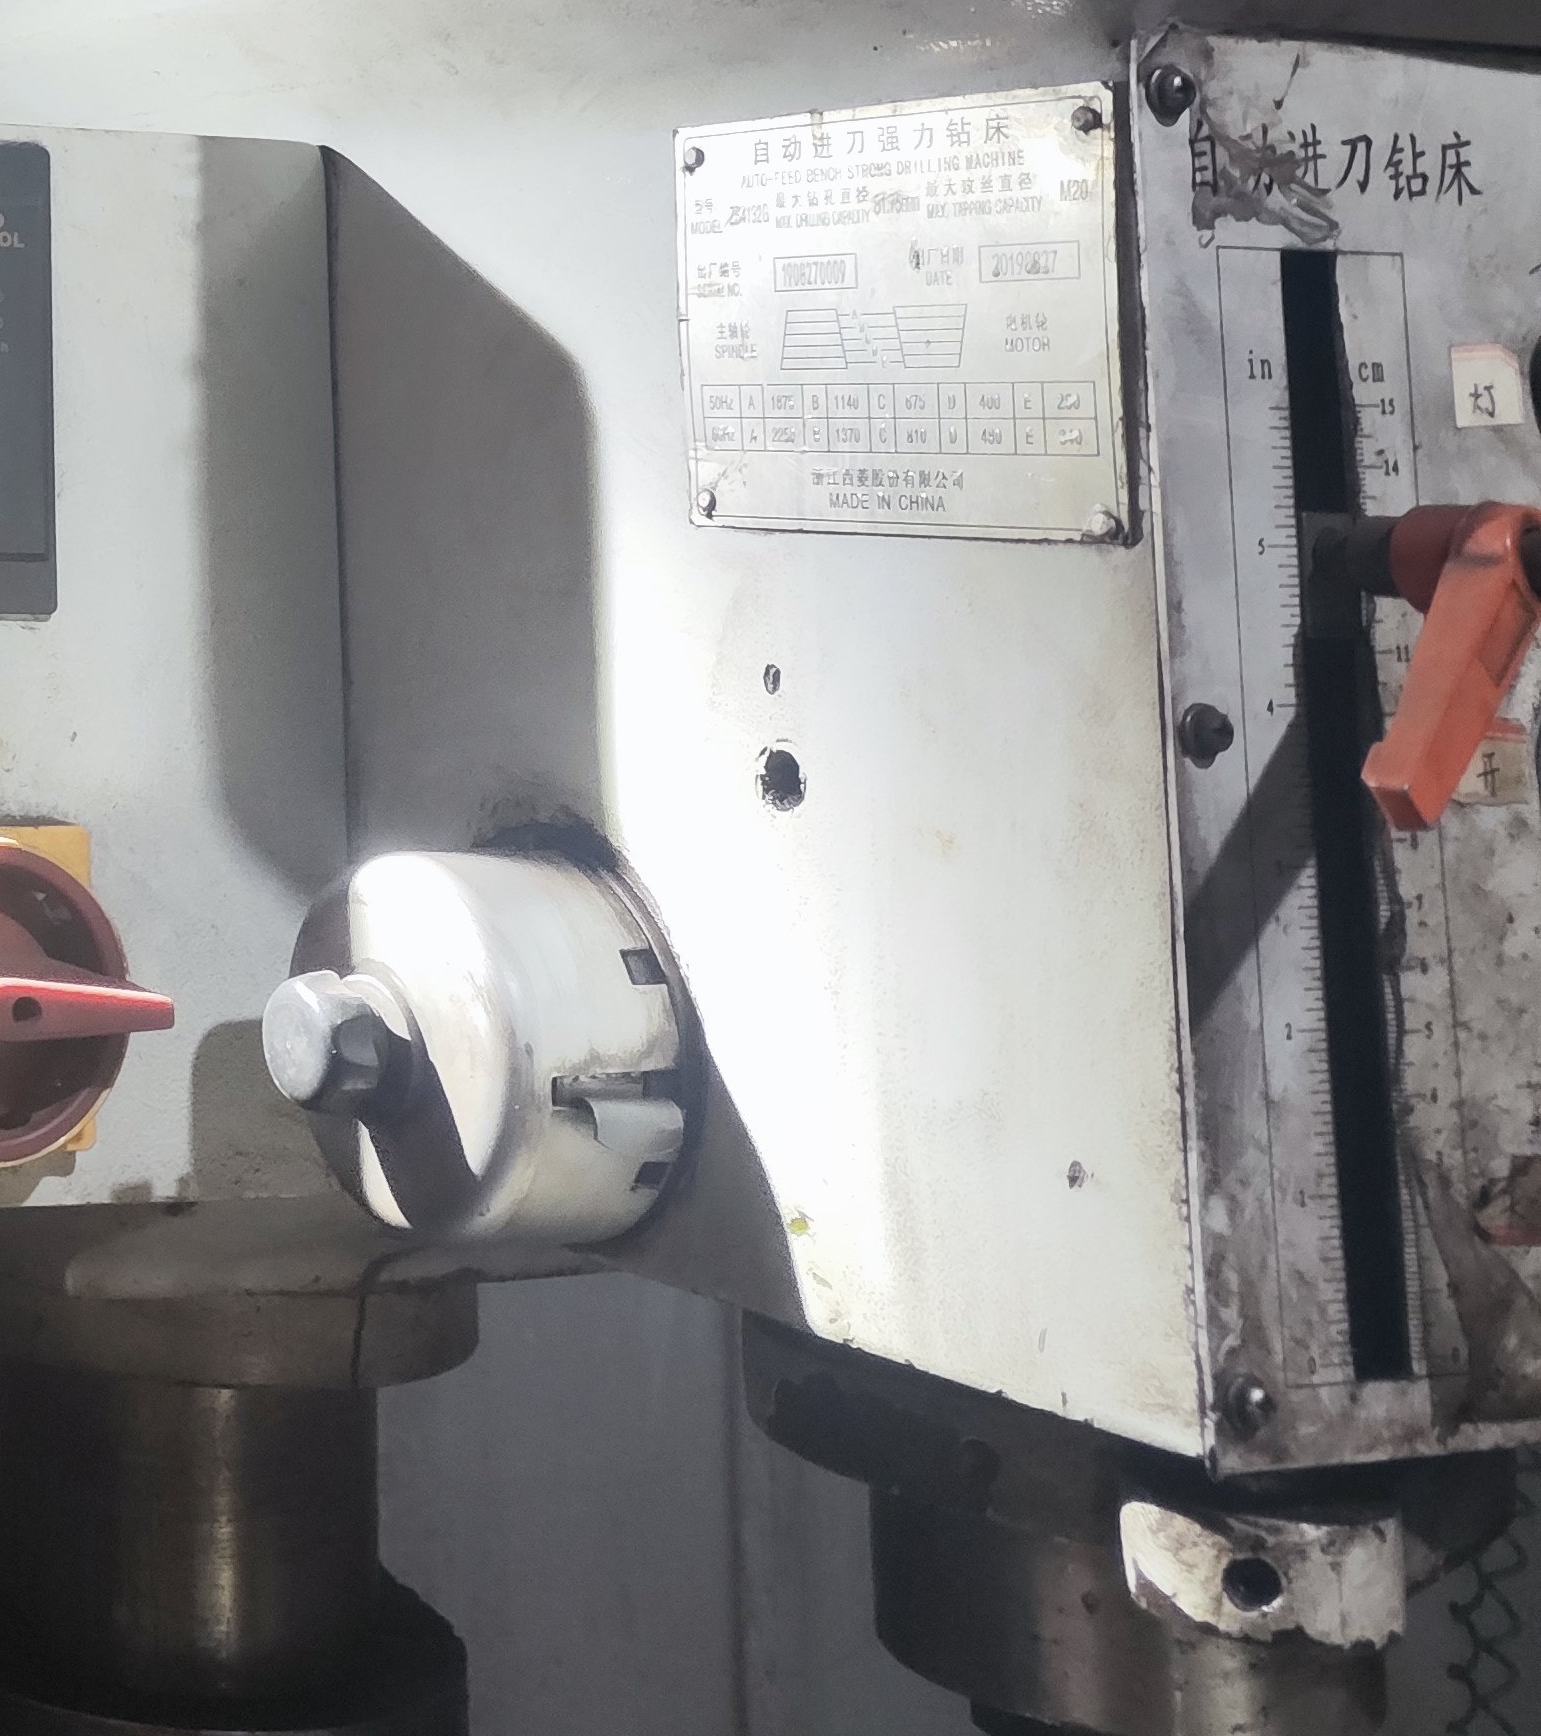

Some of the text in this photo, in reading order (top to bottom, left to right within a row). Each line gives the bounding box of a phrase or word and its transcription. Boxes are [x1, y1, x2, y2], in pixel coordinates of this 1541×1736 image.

[753, 115, 1010, 165] 自动进刀强力钻床
[806, 166, 842, 183] BENCH
[896, 156, 960, 175] DRILLING
[965, 149, 1025, 170] MACHINE
[1059, 179, 1090, 202] M20
[925, 270, 953, 287] DATE
[1004, 336, 1051, 353] MOTOR
[1247, 349, 1273, 381] in
[1358, 363, 1385, 383] cm
[709, 394, 734, 411] 50Hz
[747, 394, 755, 411] A
[811, 394, 820, 411] B
[877, 393, 886, 410] C
[1379, 397, 1396, 415] 15
[1469, 383, 1496, 419] 灯
[835, 427, 861, 443] 1370
[878, 426, 888, 444] C
[1383, 458, 1400, 477] 14
[829, 492, 947, 512] MADE IN CHINA
[1258, 537, 1266, 555] 5
